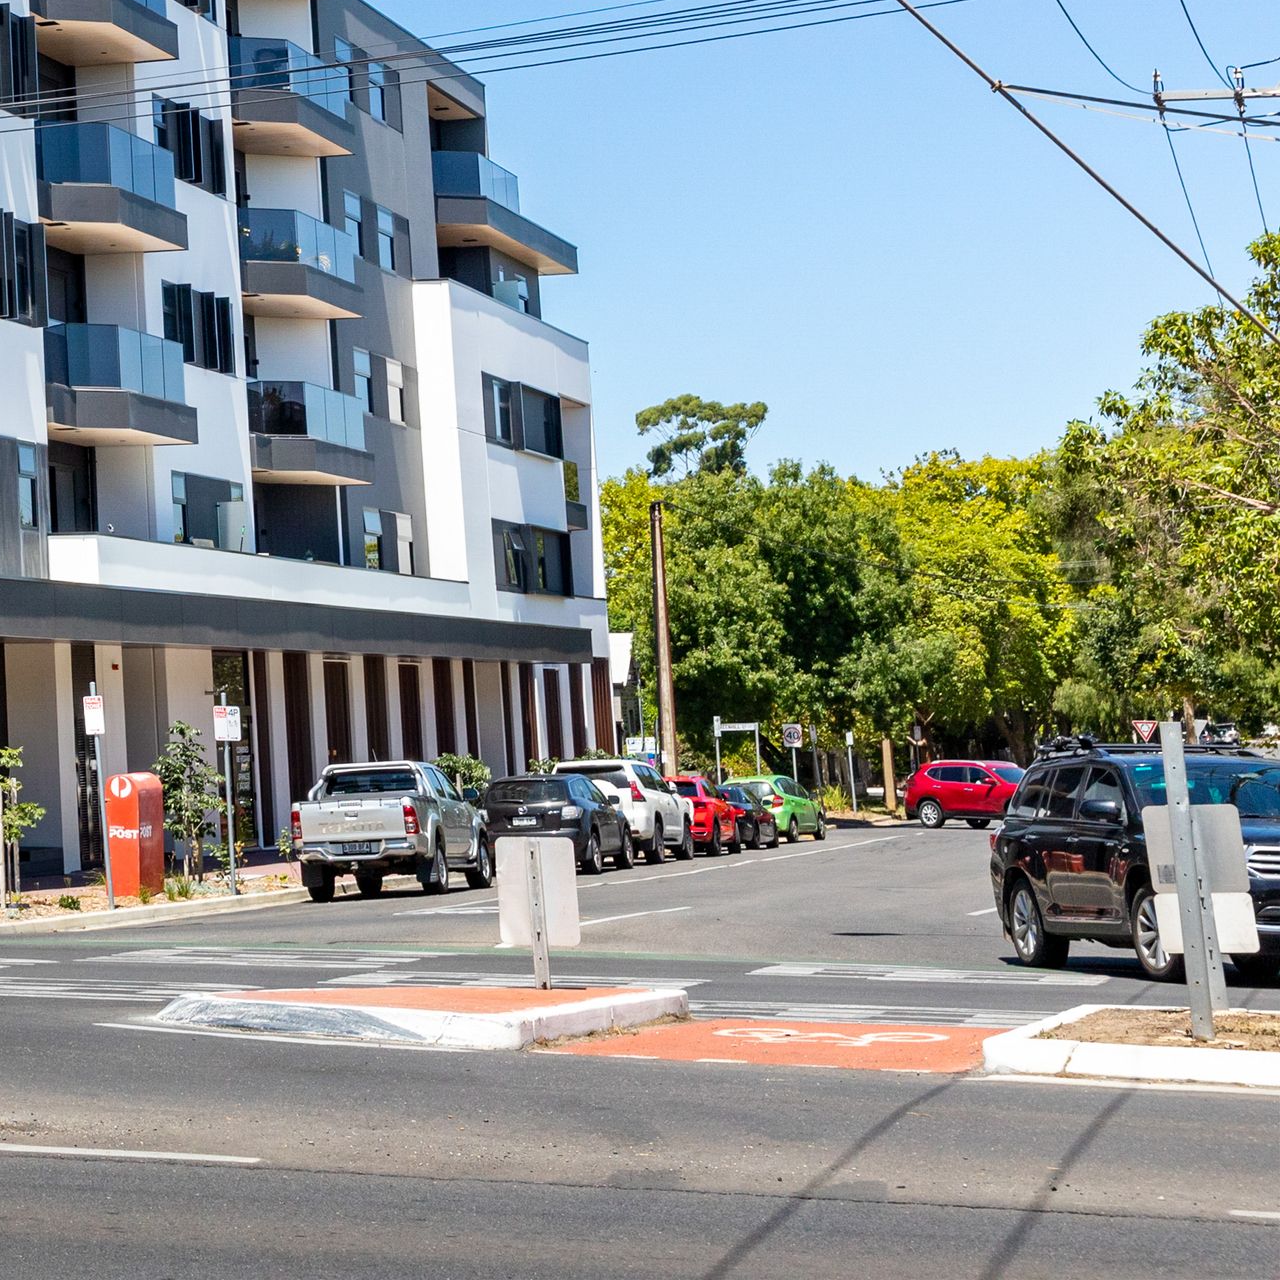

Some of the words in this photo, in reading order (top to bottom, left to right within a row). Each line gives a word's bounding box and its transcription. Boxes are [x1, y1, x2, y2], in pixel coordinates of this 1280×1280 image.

[228, 708, 238, 716] 4P
[786, 731, 799, 740] 40
[318, 821, 386, 834] TOYOTA
[109, 829, 139, 839] POST
